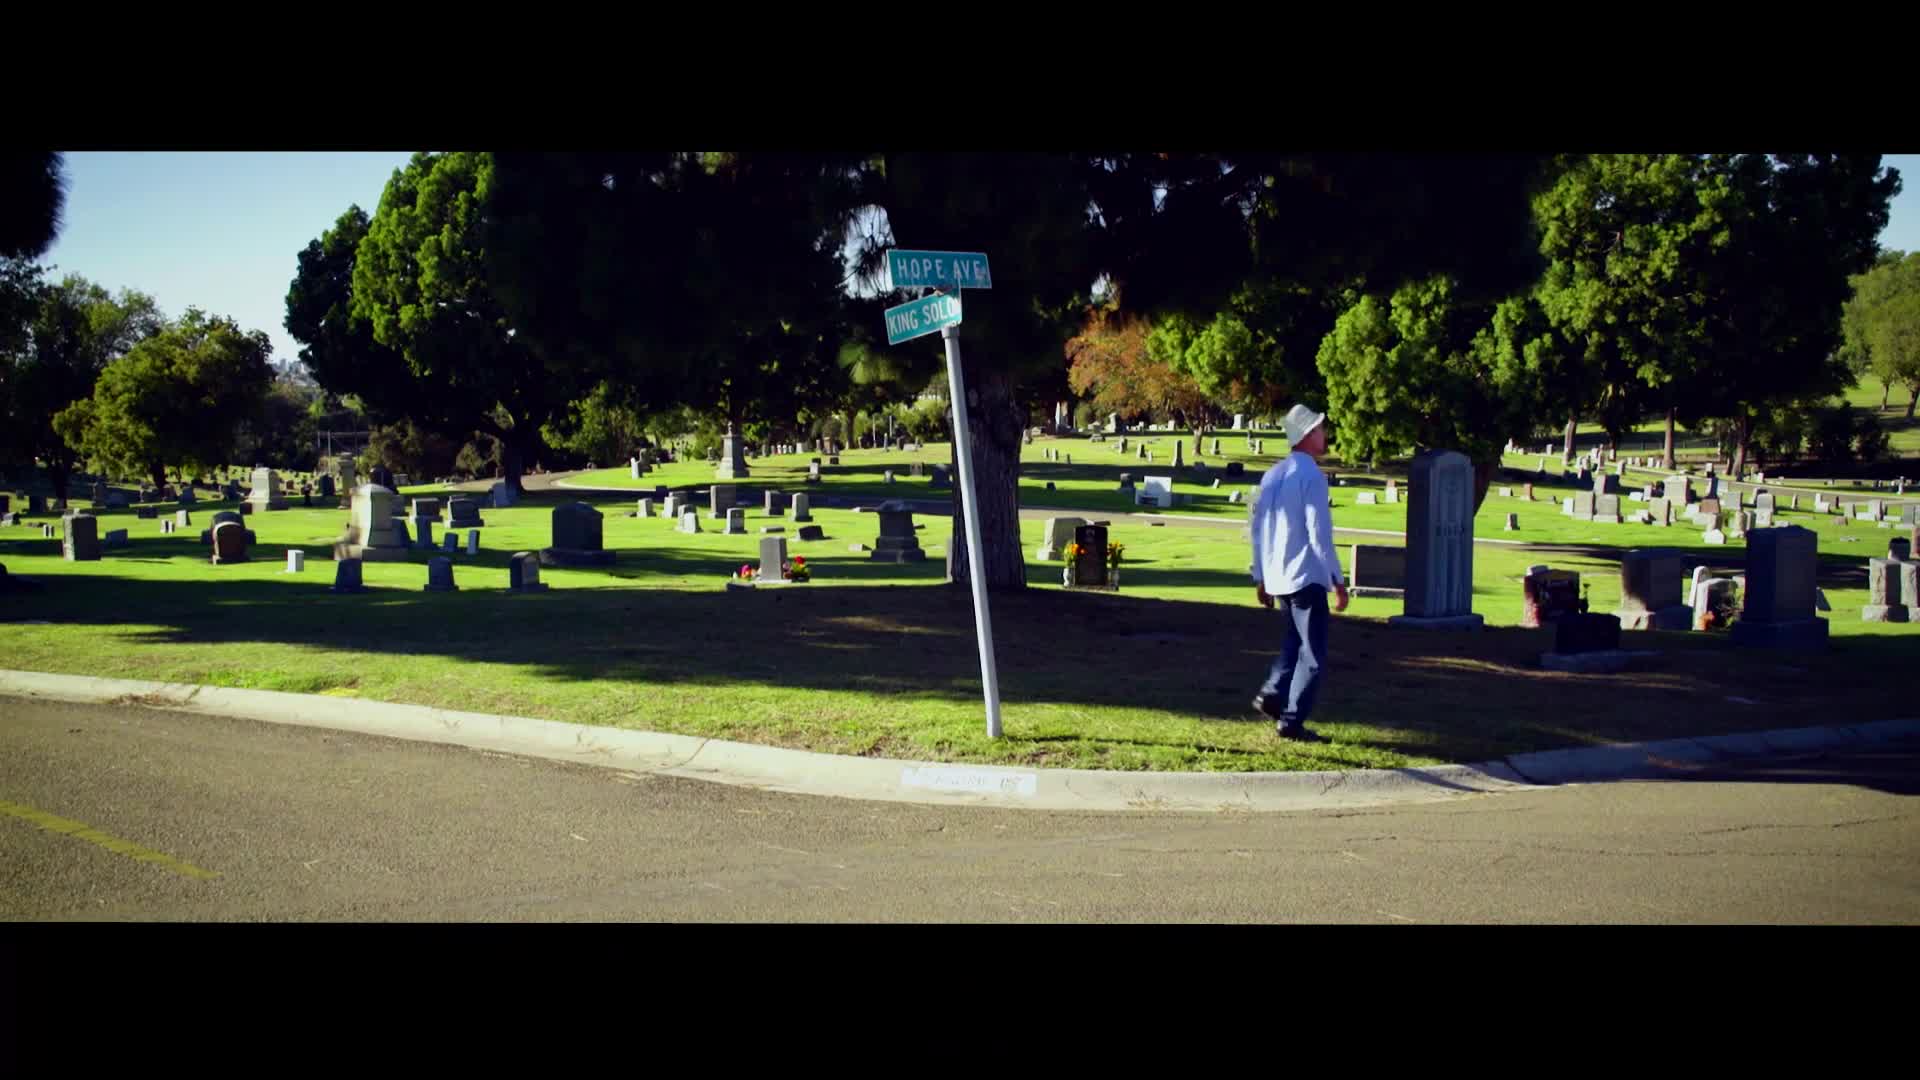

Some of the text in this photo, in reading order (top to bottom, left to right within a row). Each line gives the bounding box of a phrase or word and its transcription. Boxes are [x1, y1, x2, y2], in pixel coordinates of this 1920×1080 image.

[897, 258, 986, 280] HOPE AVE
[888, 310, 919, 337] KING
